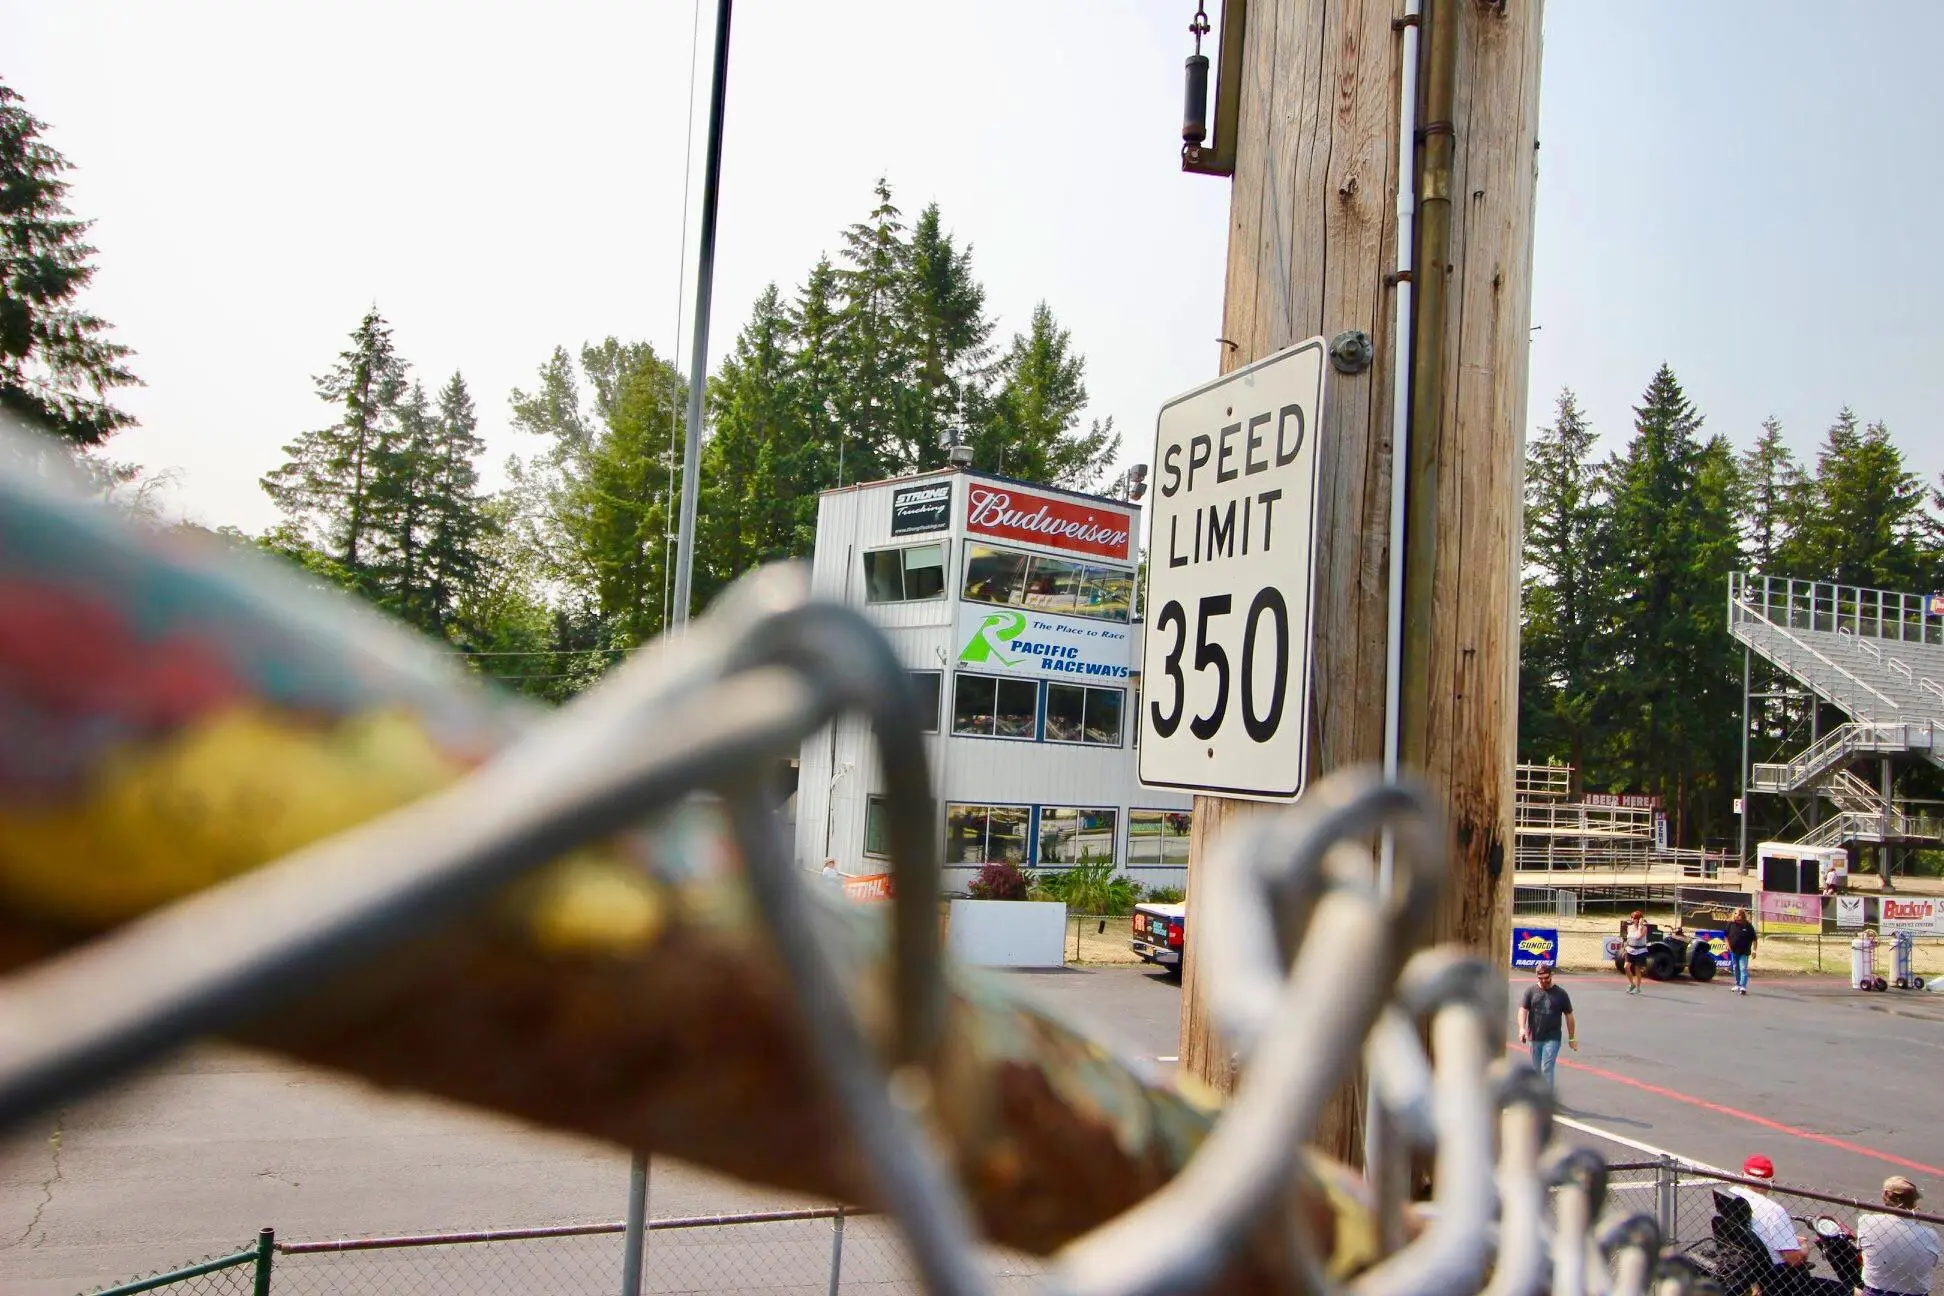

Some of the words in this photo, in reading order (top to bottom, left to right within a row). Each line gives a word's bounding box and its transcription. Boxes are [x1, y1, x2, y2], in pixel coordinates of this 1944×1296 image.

[1162, 403, 1305, 498] SPEED
[896, 487, 949, 504] STRONG
[896, 505, 946, 517] Trucking
[969, 490, 1127, 546] Budweiser
[1169, 489, 1282, 568] LIMIT
[1032, 621, 1052, 631] The
[1056, 624, 1084, 635] Place
[1086, 627, 1098, 637] to
[1101, 631, 1126, 640] Race
[1010, 640, 1079, 659] PACIFIC
[1041, 658, 1129, 678] RACEWAYS
[1151, 586, 1289, 744] 350
[1883, 900, 1934, 920] Bucky's
[1520, 941, 1552, 950] SUNOCO
